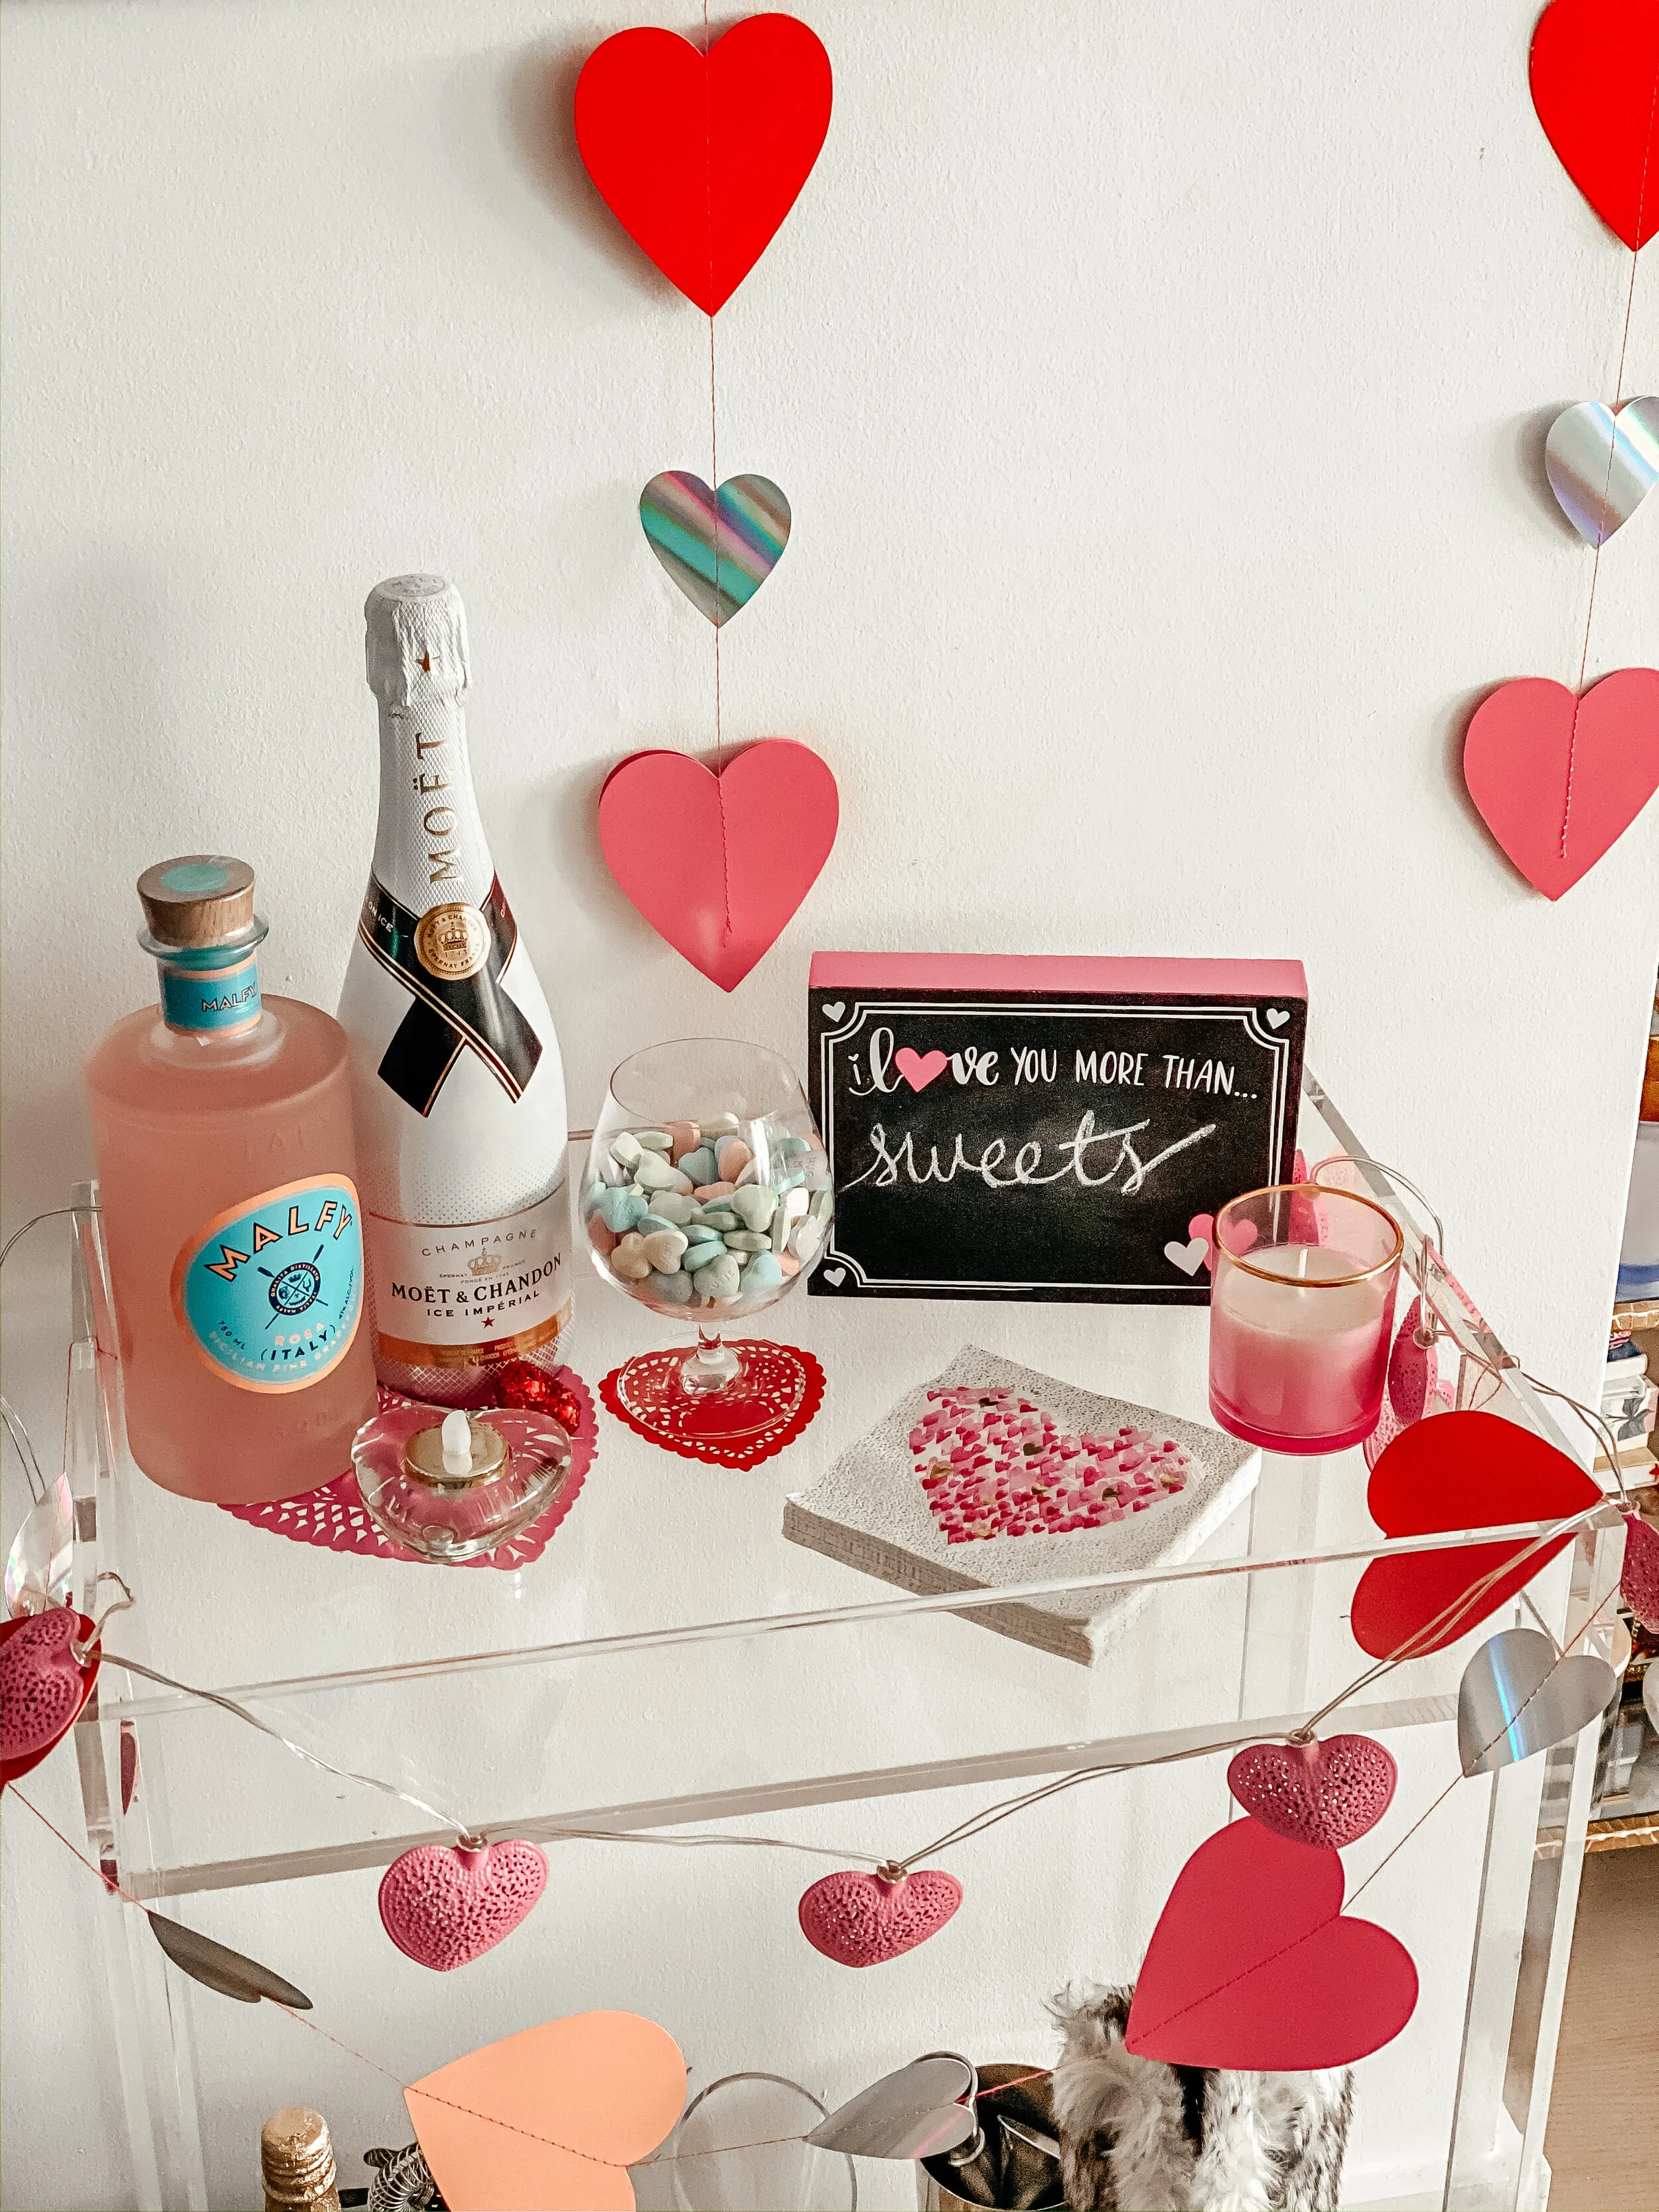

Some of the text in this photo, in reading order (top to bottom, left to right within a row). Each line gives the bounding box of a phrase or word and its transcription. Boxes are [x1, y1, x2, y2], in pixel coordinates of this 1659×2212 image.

[368, 901, 394, 932] ON ICE
[201, 981, 257, 1012] MALFY
[1010, 1046, 1057, 1084] YOU
[1076, 1051, 1147, 1086] MORE
[837, 1110, 1216, 1195] sweets
[204, 1200, 353, 1283] MALFY
[421, 1228, 537, 1256] CHAMPAGNE
[392, 1251, 562, 1303] MOËT & CHANDON
[427, 1290, 540, 1317] ICE IMPÉRIAL
[233, 1337, 246, 1351] ML
[261, 1323, 336, 1361] (ITALY)
